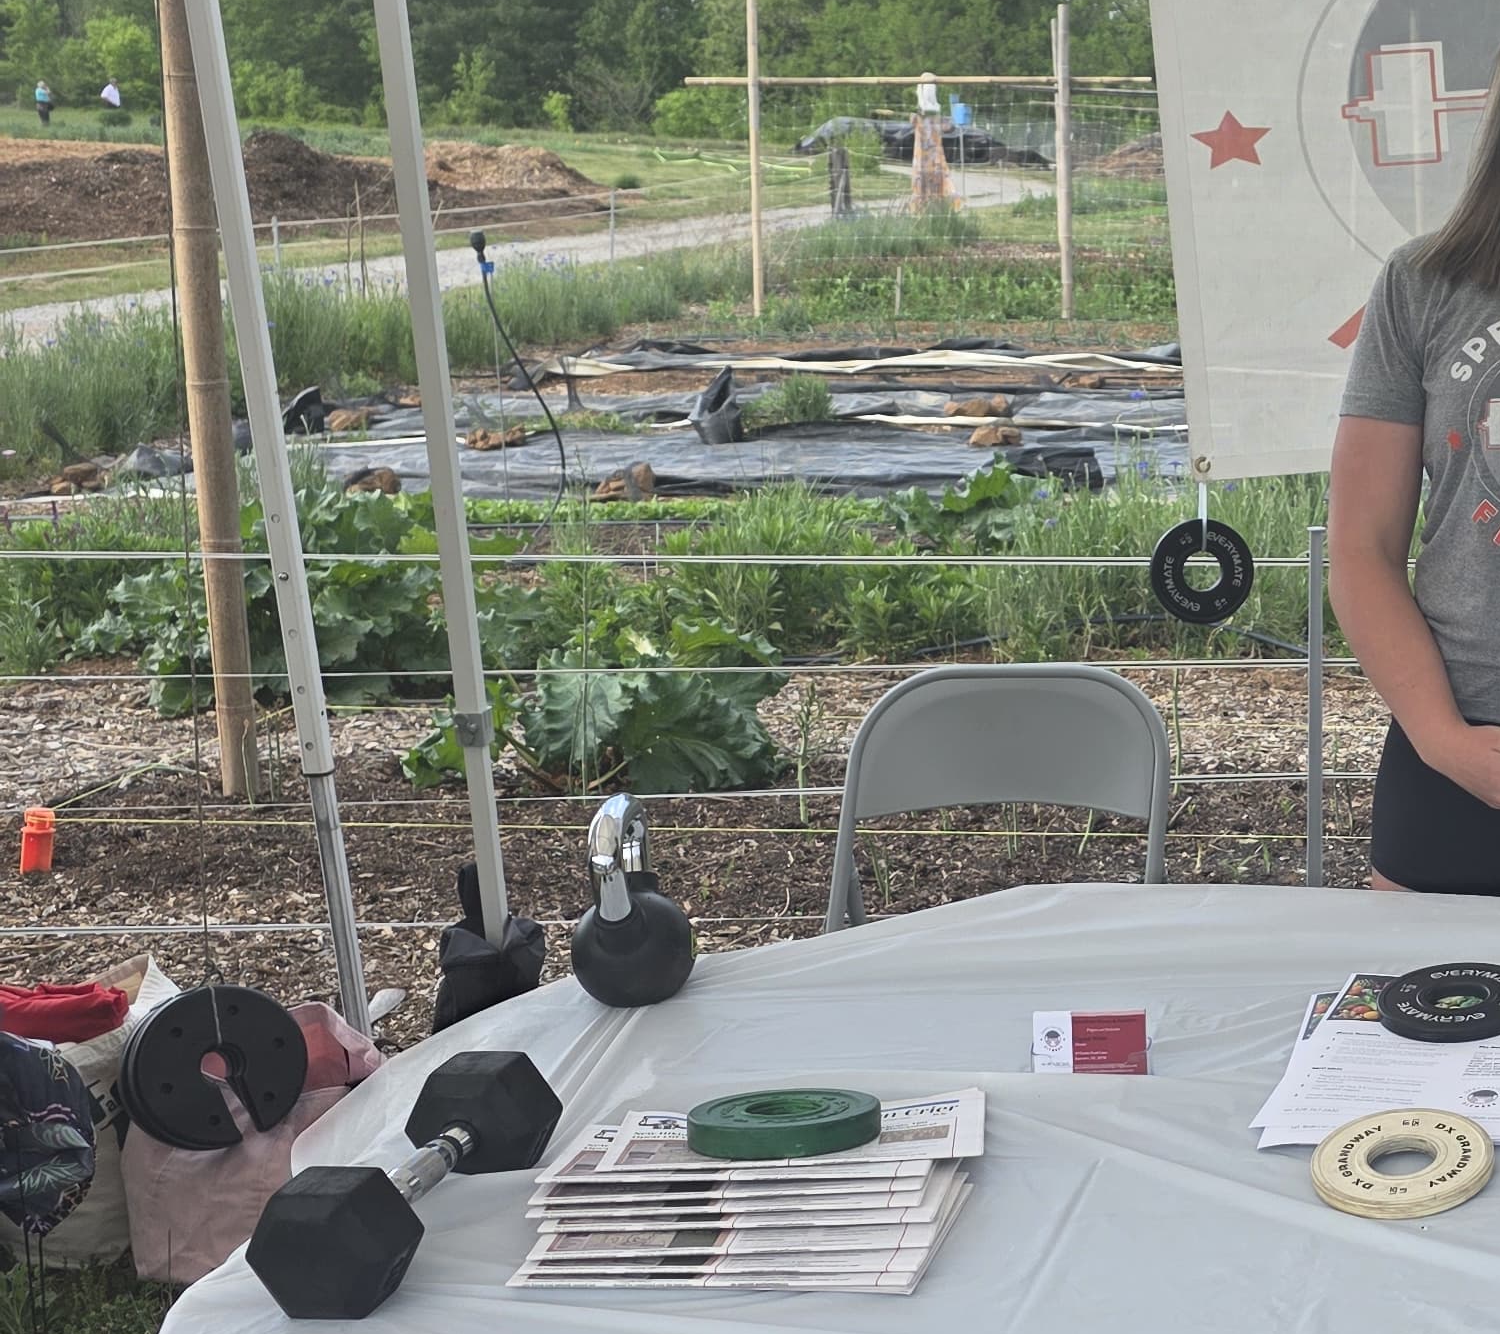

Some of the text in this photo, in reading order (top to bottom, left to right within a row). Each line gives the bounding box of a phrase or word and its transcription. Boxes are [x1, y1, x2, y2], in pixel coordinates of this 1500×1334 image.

[1163, 555, 1201, 612] EVERYMATE
[1206, 531, 1245, 587] EVERYMATE
[1397, 1001, 1486, 1023] EVERYMATE
[1337, 1125, 1382, 1190] DX GRANDWAY
[1429, 1122, 1472, 1188] DX GRANDWAY
